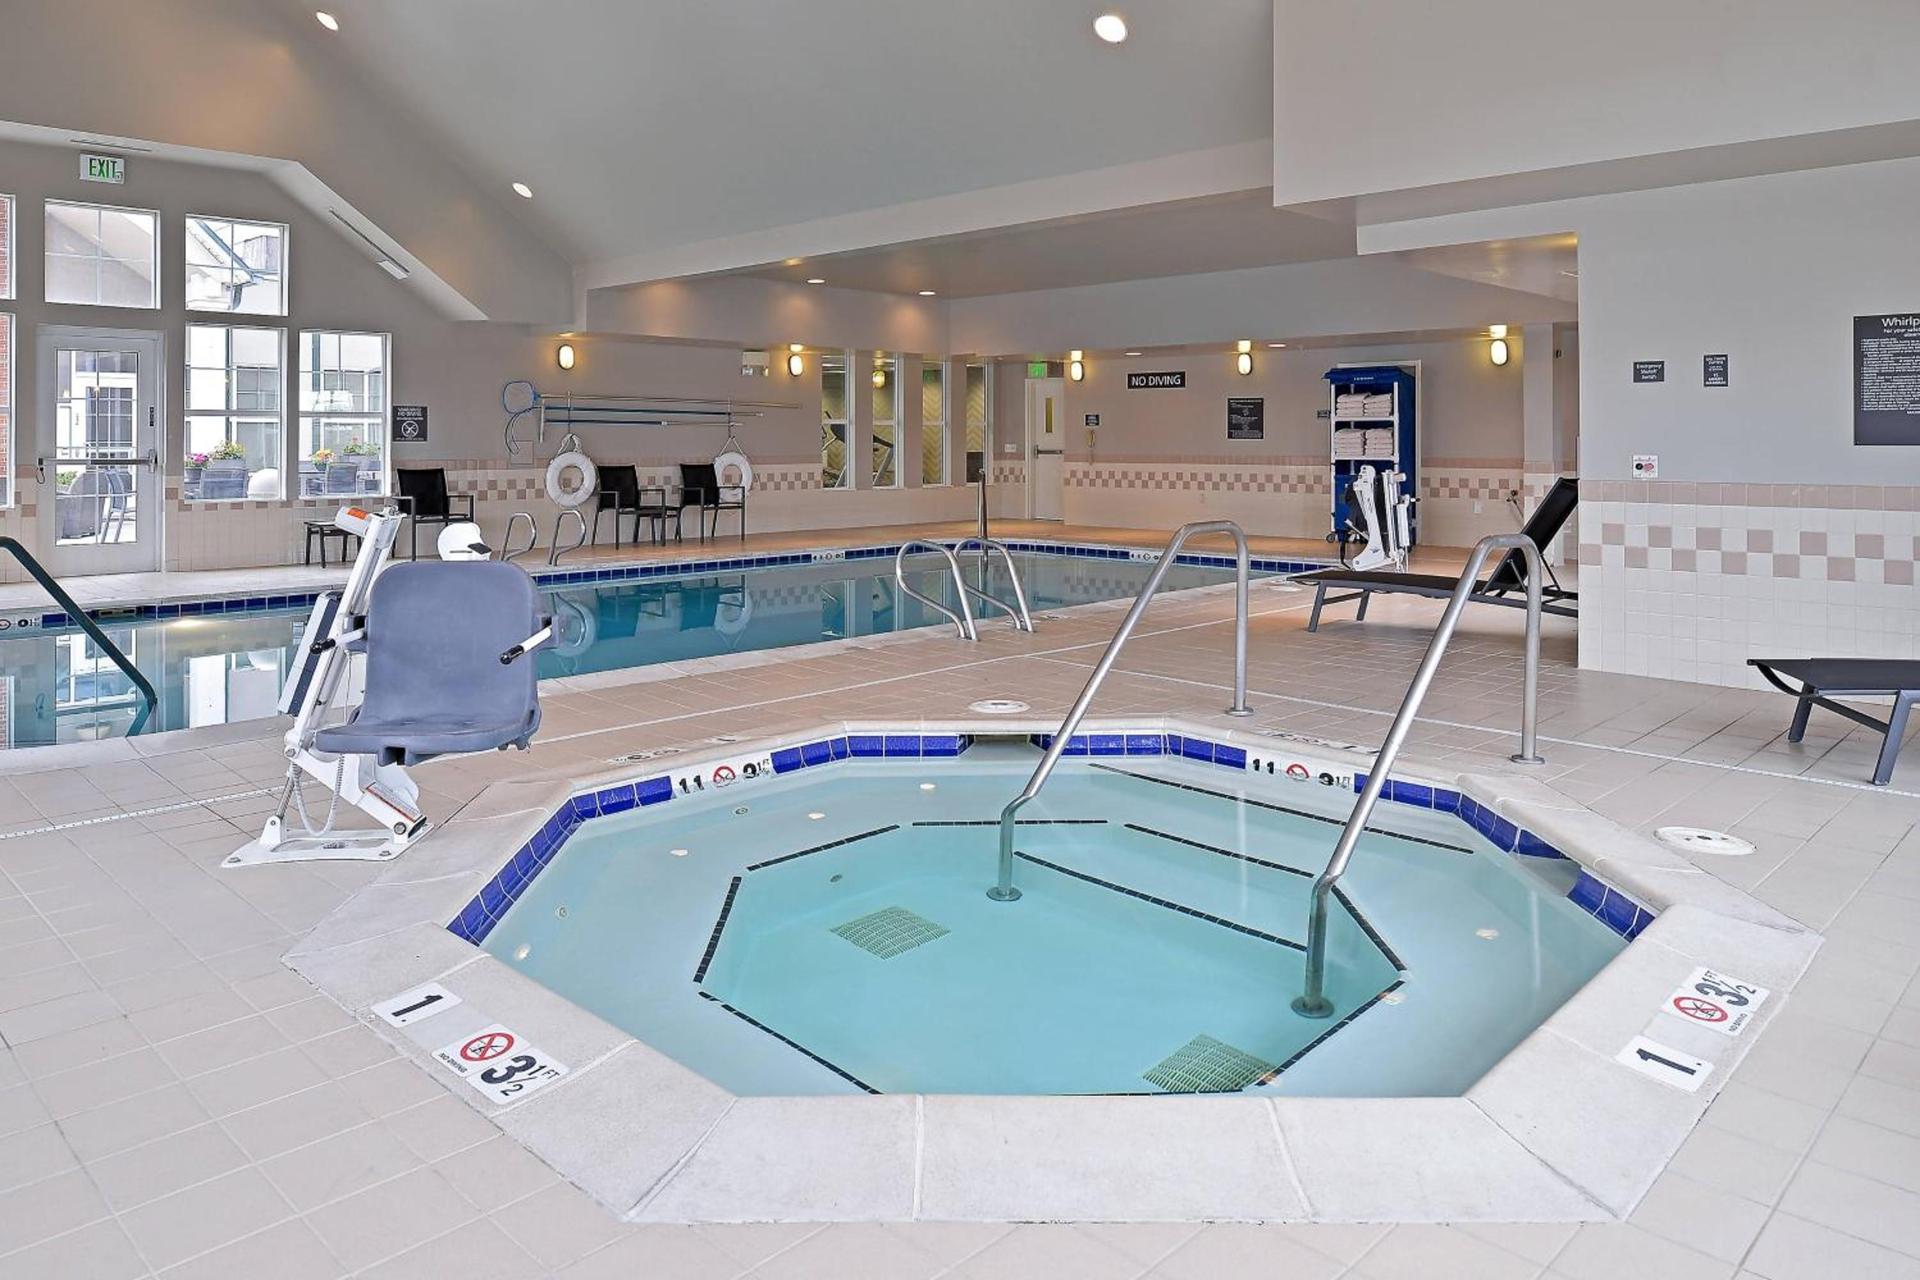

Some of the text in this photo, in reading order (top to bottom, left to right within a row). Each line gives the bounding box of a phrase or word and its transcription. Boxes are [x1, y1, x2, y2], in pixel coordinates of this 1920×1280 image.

[89, 157, 117, 178] EXIT
[1131, 374, 1181, 387] NO DIVING
[542, 1067, 560, 1080] FT
